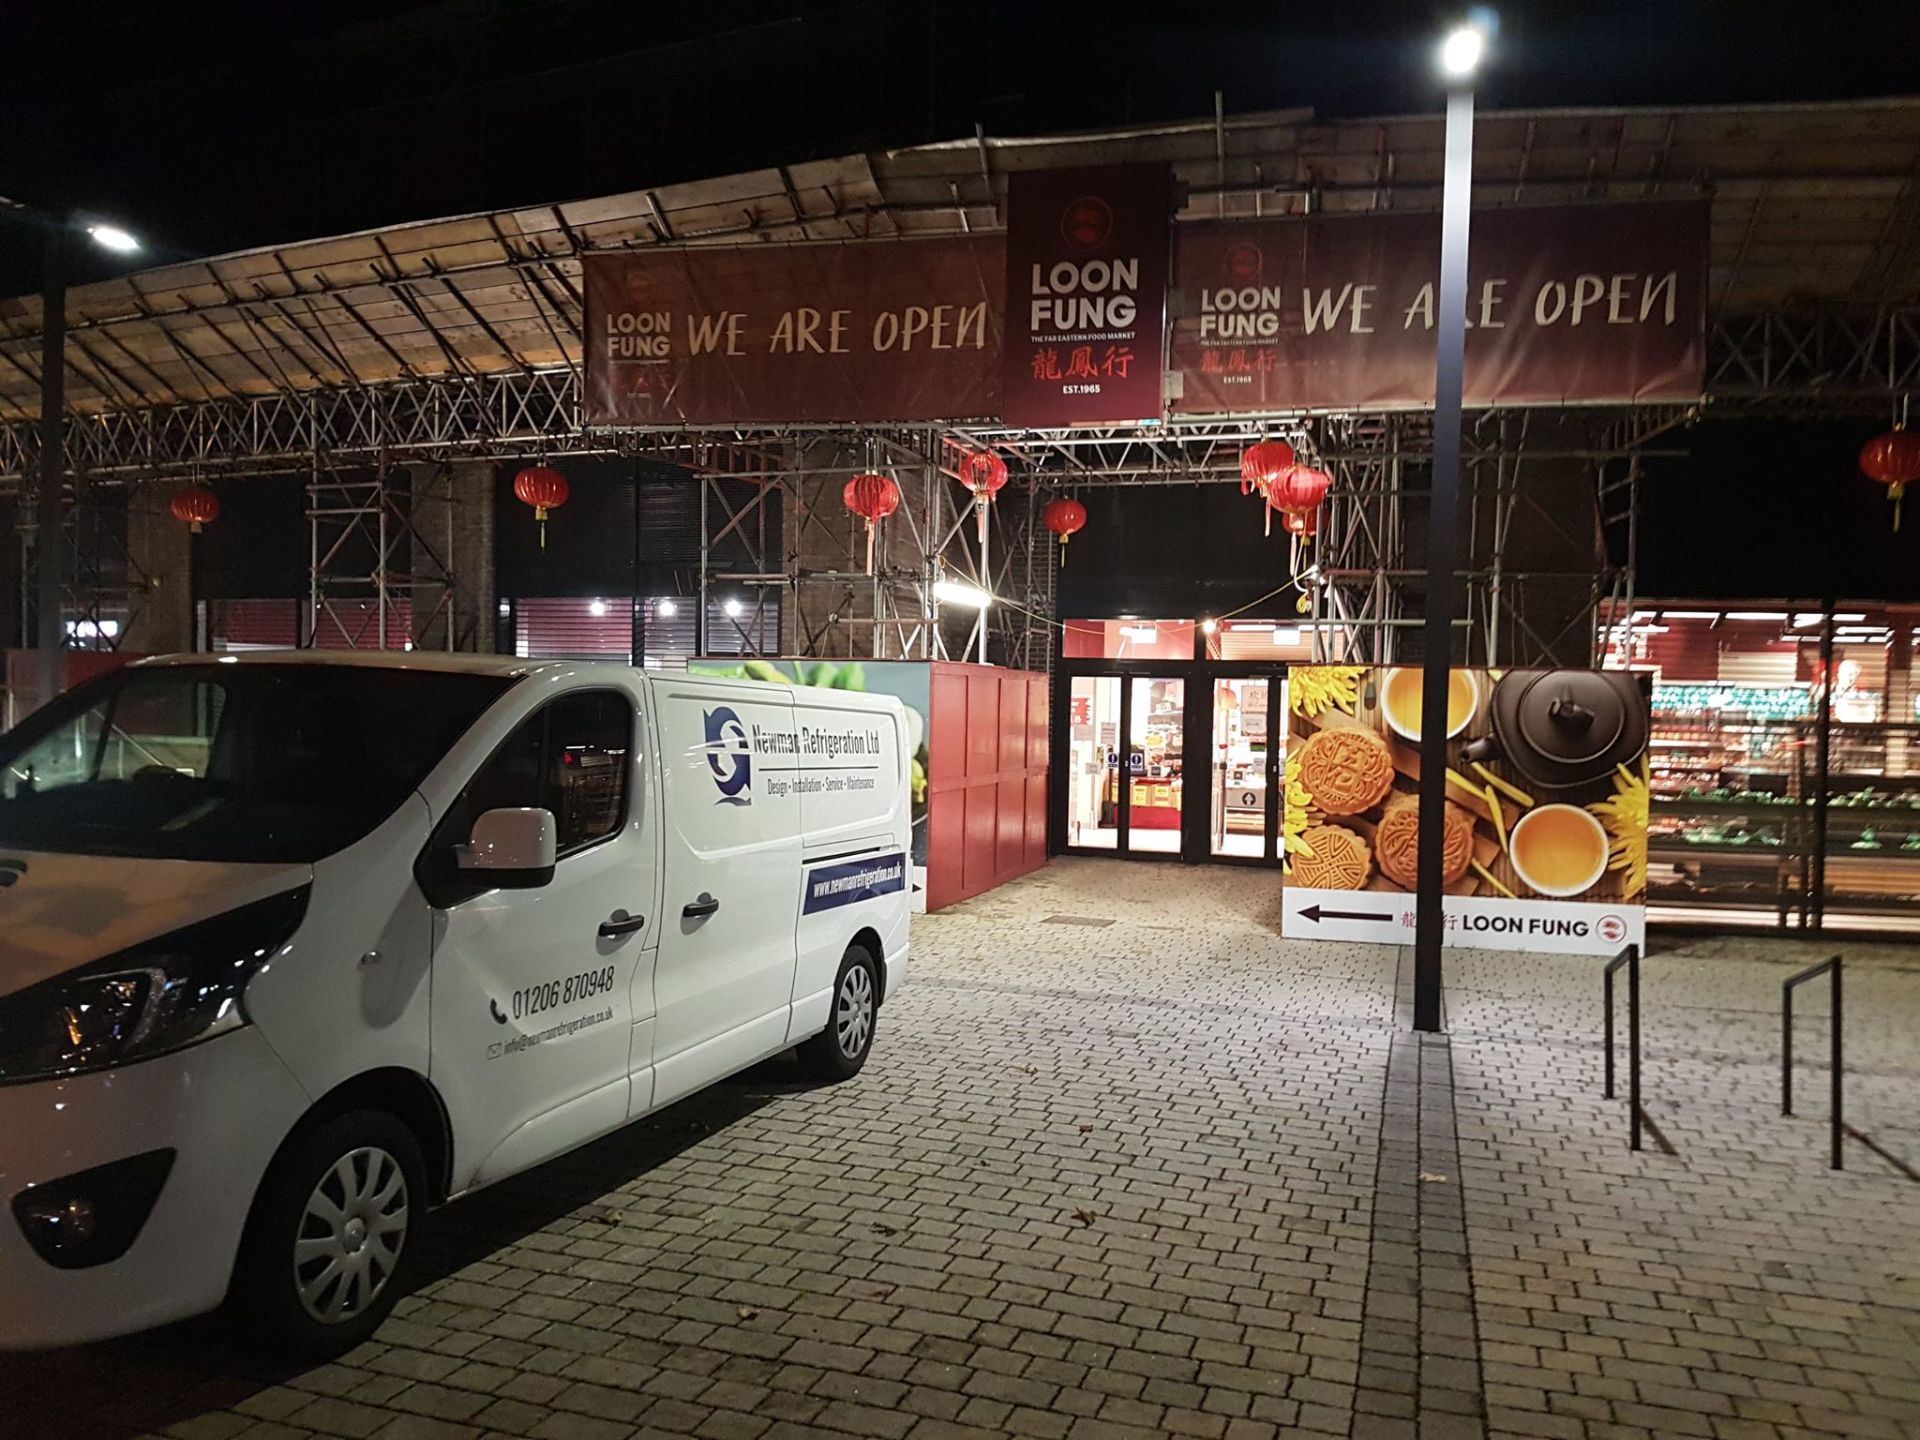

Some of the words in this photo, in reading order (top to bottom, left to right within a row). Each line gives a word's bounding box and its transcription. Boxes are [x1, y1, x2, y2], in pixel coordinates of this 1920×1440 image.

[1031, 258, 1138, 295] LOON
[1031, 294, 1137, 331] FUNG
[1202, 286, 1281, 312] LOON
[1303, 281, 1377, 336] WE
[1404, 278, 1508, 331] AE
[1534, 271, 1678, 327] OPEN
[607, 311, 670, 334] LOON
[687, 310, 748, 357] WE
[769, 308, 852, 354] ARE
[872, 302, 987, 352] OPEN
[1044, 334, 1057, 342] FAR
[1057, 333, 1087, 342] EASTERN
[1088, 332, 1106, 341] FOOD
[1107, 331, 1135, 340] MARKET
[1200, 312, 1280, 338] FUNG
[607, 335, 670, 358] FUNG
[1031, 345, 1134, 380] 龍鳳行
[1063, 384, 1101, 395] EST.1965
[752, 724, 799, 754] Newman
[802, 727, 865, 759] Refrigeration
[866, 730, 880, 754] Ltd
[767, 778, 788, 797] Design
[792, 776, 821, 793] Installation
[825, 777, 844, 792] Service
[813, 861, 902, 898] www.newmanrefrigeration.co.uk
[1400, 911, 1458, 931] 龍行
[1463, 914, 1523, 935] LOON
[1529, 918, 1590, 937] FUNG
[513, 981, 561, 1020] 01206
[563, 965, 615, 1005] 870948
